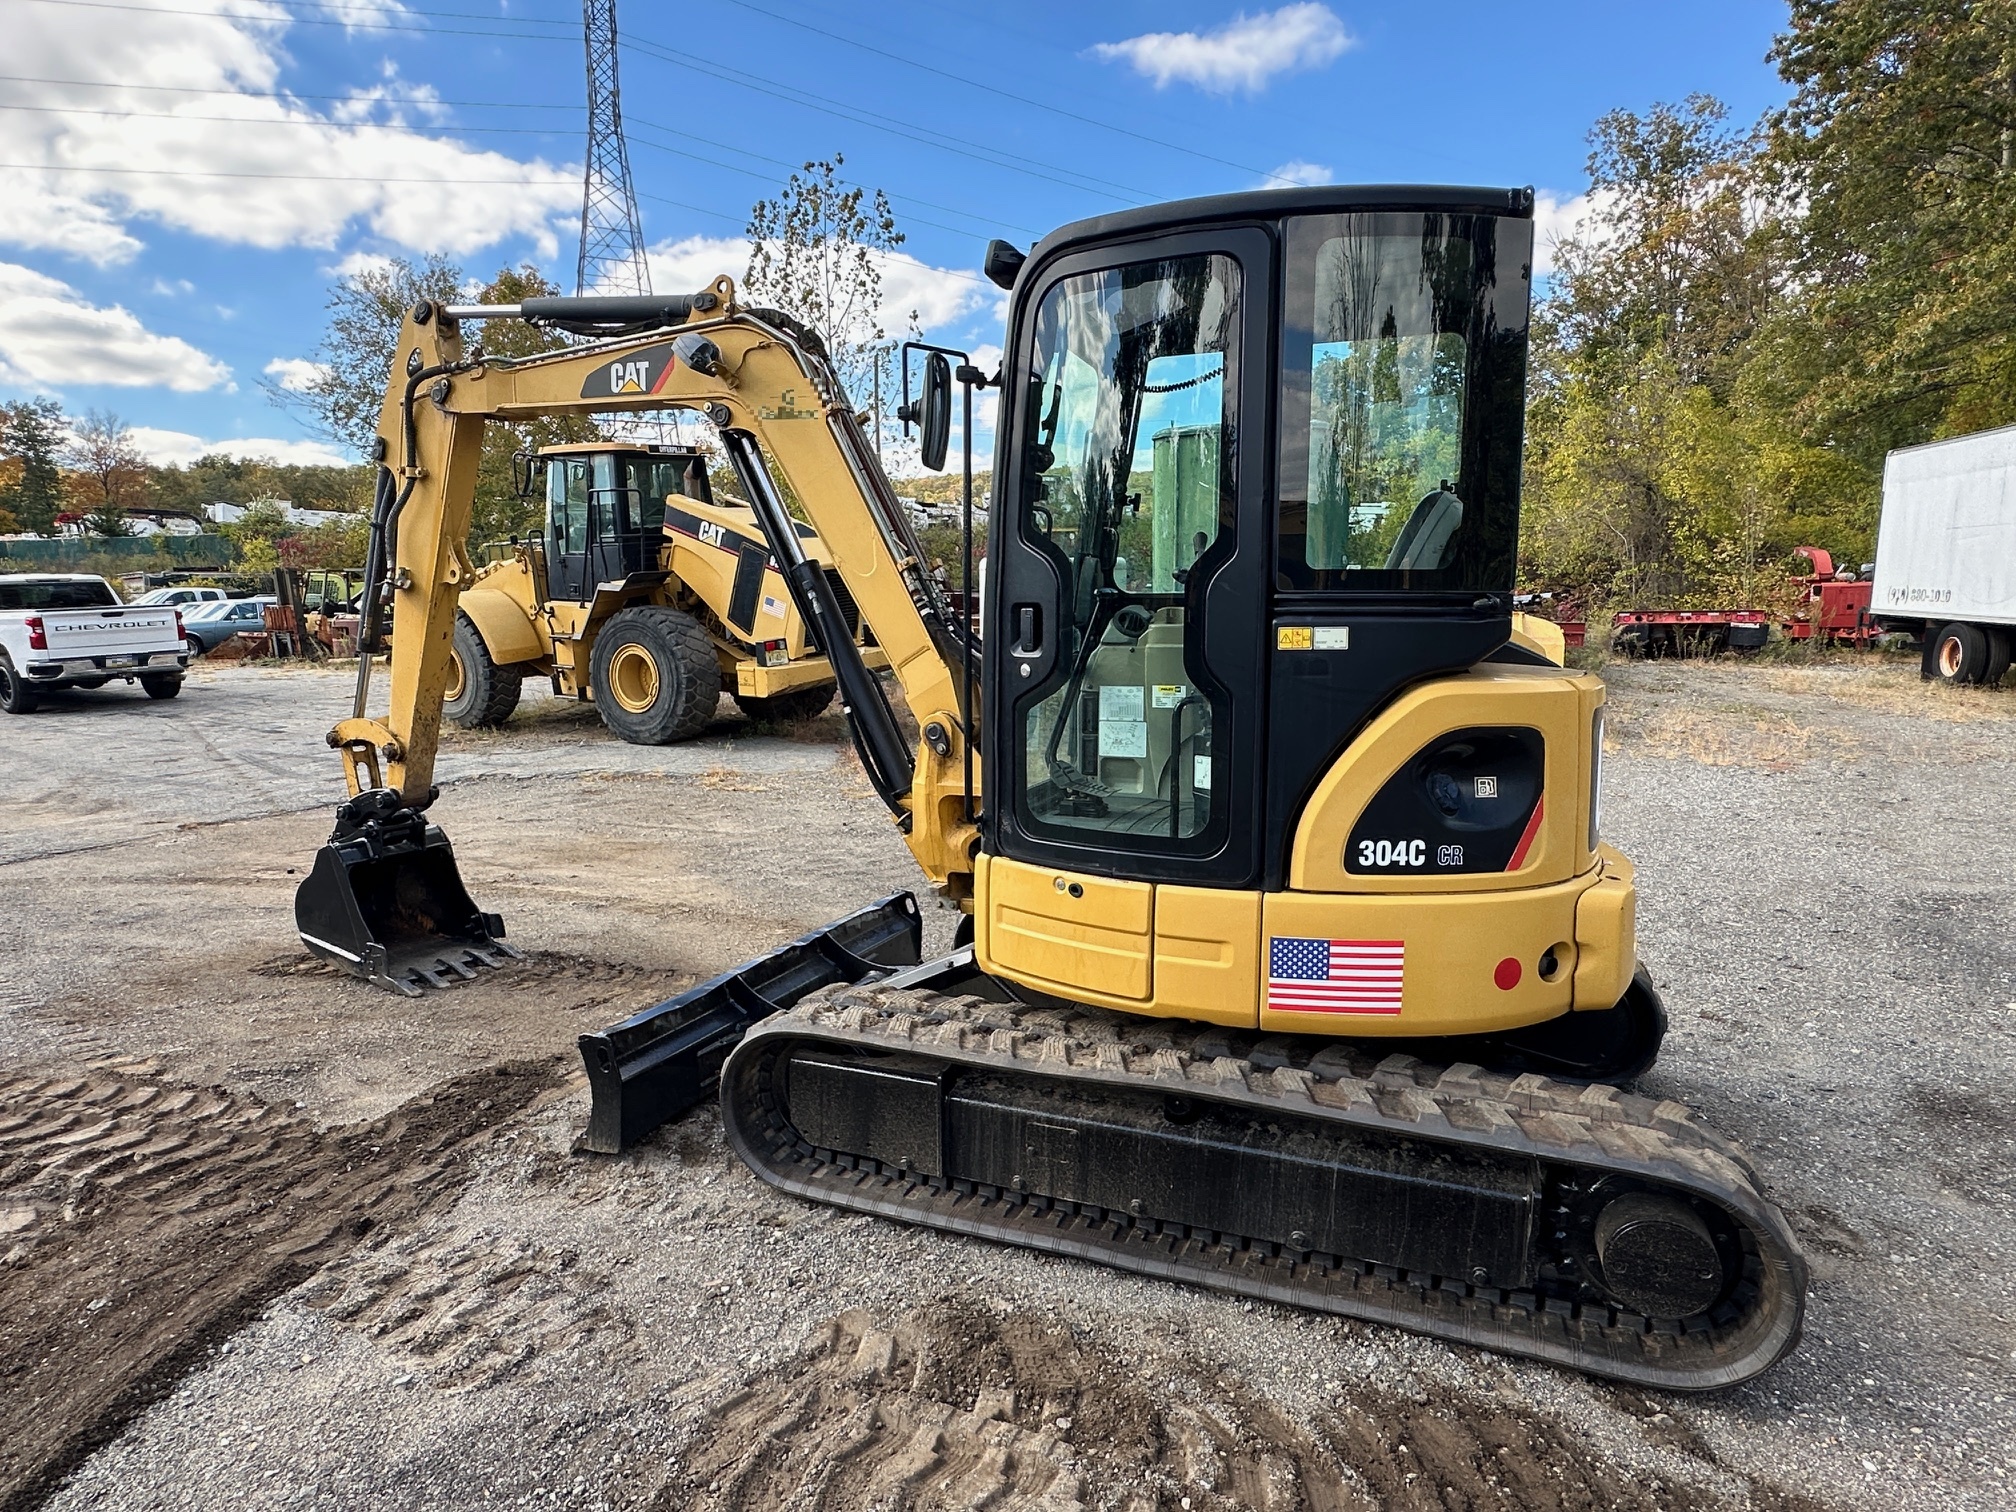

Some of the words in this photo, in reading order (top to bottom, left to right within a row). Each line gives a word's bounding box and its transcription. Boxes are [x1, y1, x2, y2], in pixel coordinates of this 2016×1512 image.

[610, 361, 649, 394] CAT
[698, 521, 726, 547] CAT
[55, 620, 167, 632] CHEVROLET
[1358, 839, 1426, 866] 304C
[1437, 845, 1464, 866] CR
